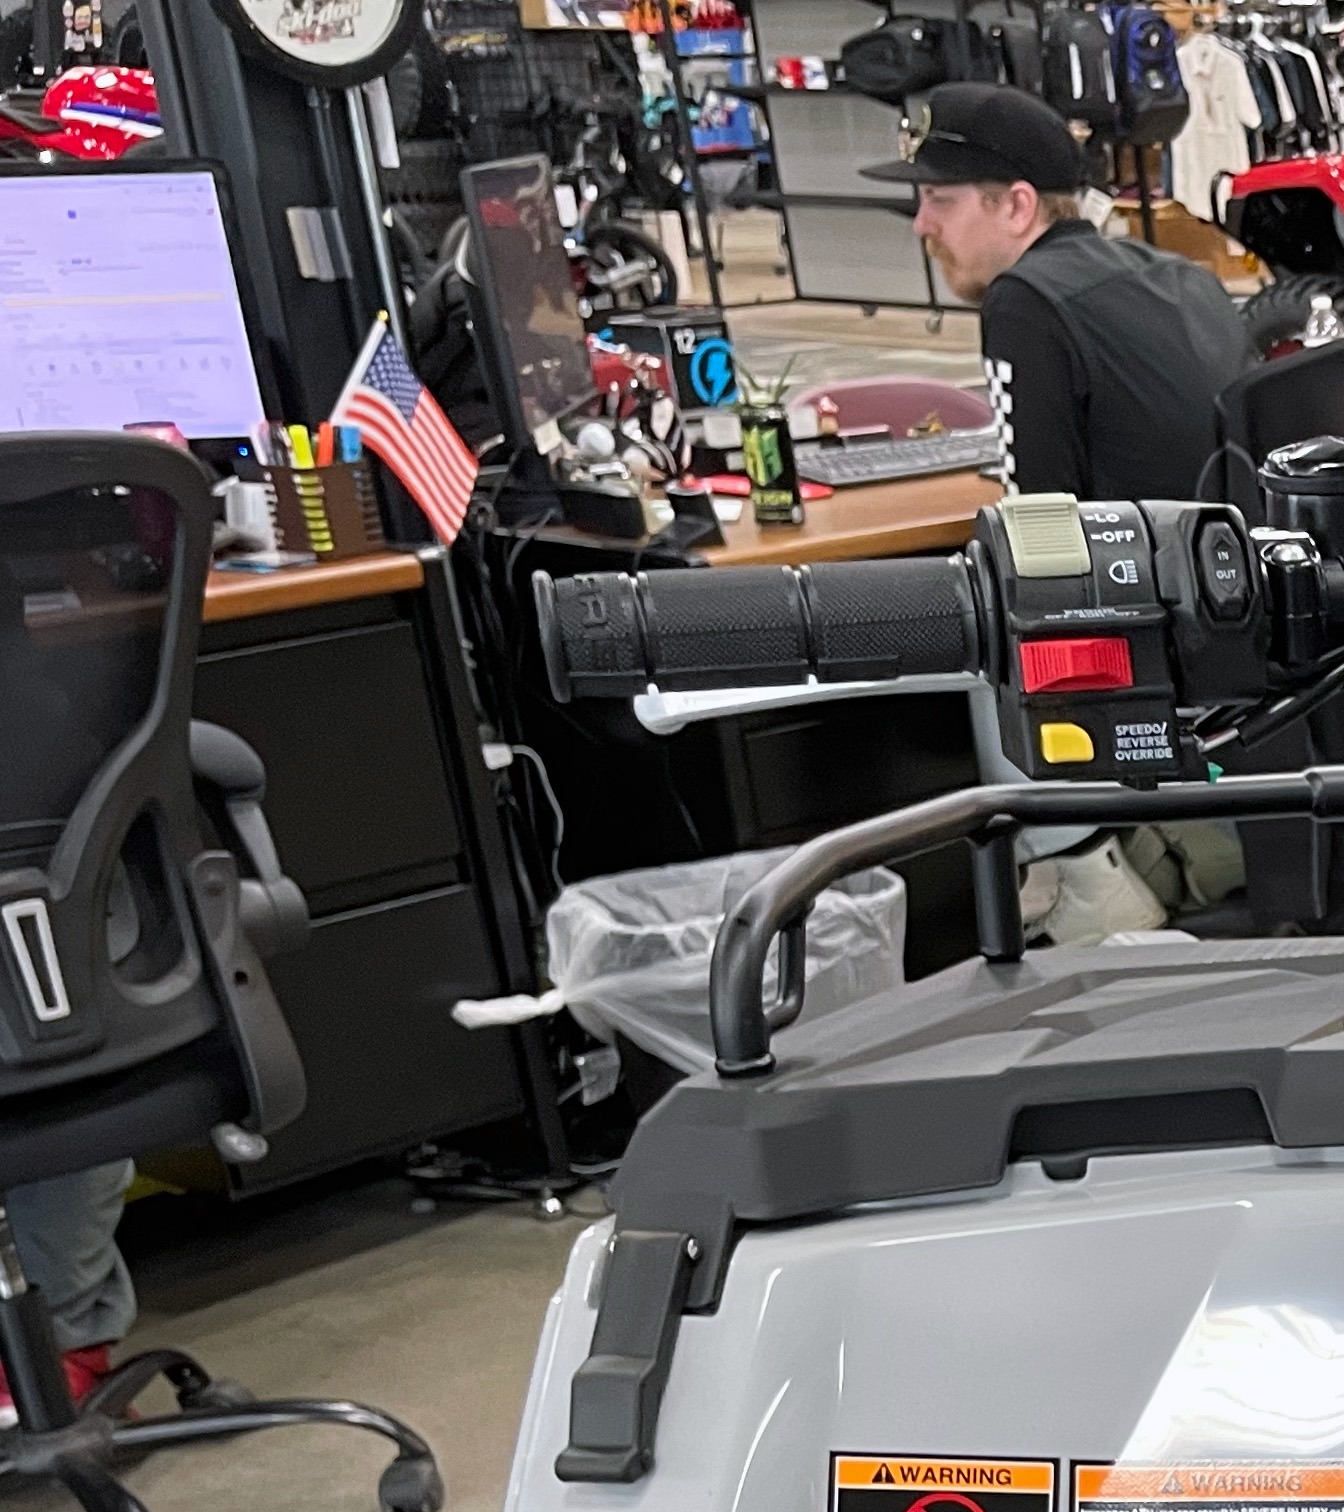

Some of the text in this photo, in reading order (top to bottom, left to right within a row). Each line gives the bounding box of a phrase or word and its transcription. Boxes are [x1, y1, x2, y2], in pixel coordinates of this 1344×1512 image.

[1102, 530, 1135, 543] OFF
[1217, 551, 1229, 561] IN
[1216, 569, 1237, 580] OUT
[1115, 722, 1167, 737] SPEEDO/
[1117, 736, 1169, 748] REVERSE
[1115, 747, 1173, 761] OVERRIDE
[900, 1466, 1012, 1486] WARNING
[1192, 1475, 1303, 1492] WARNING
